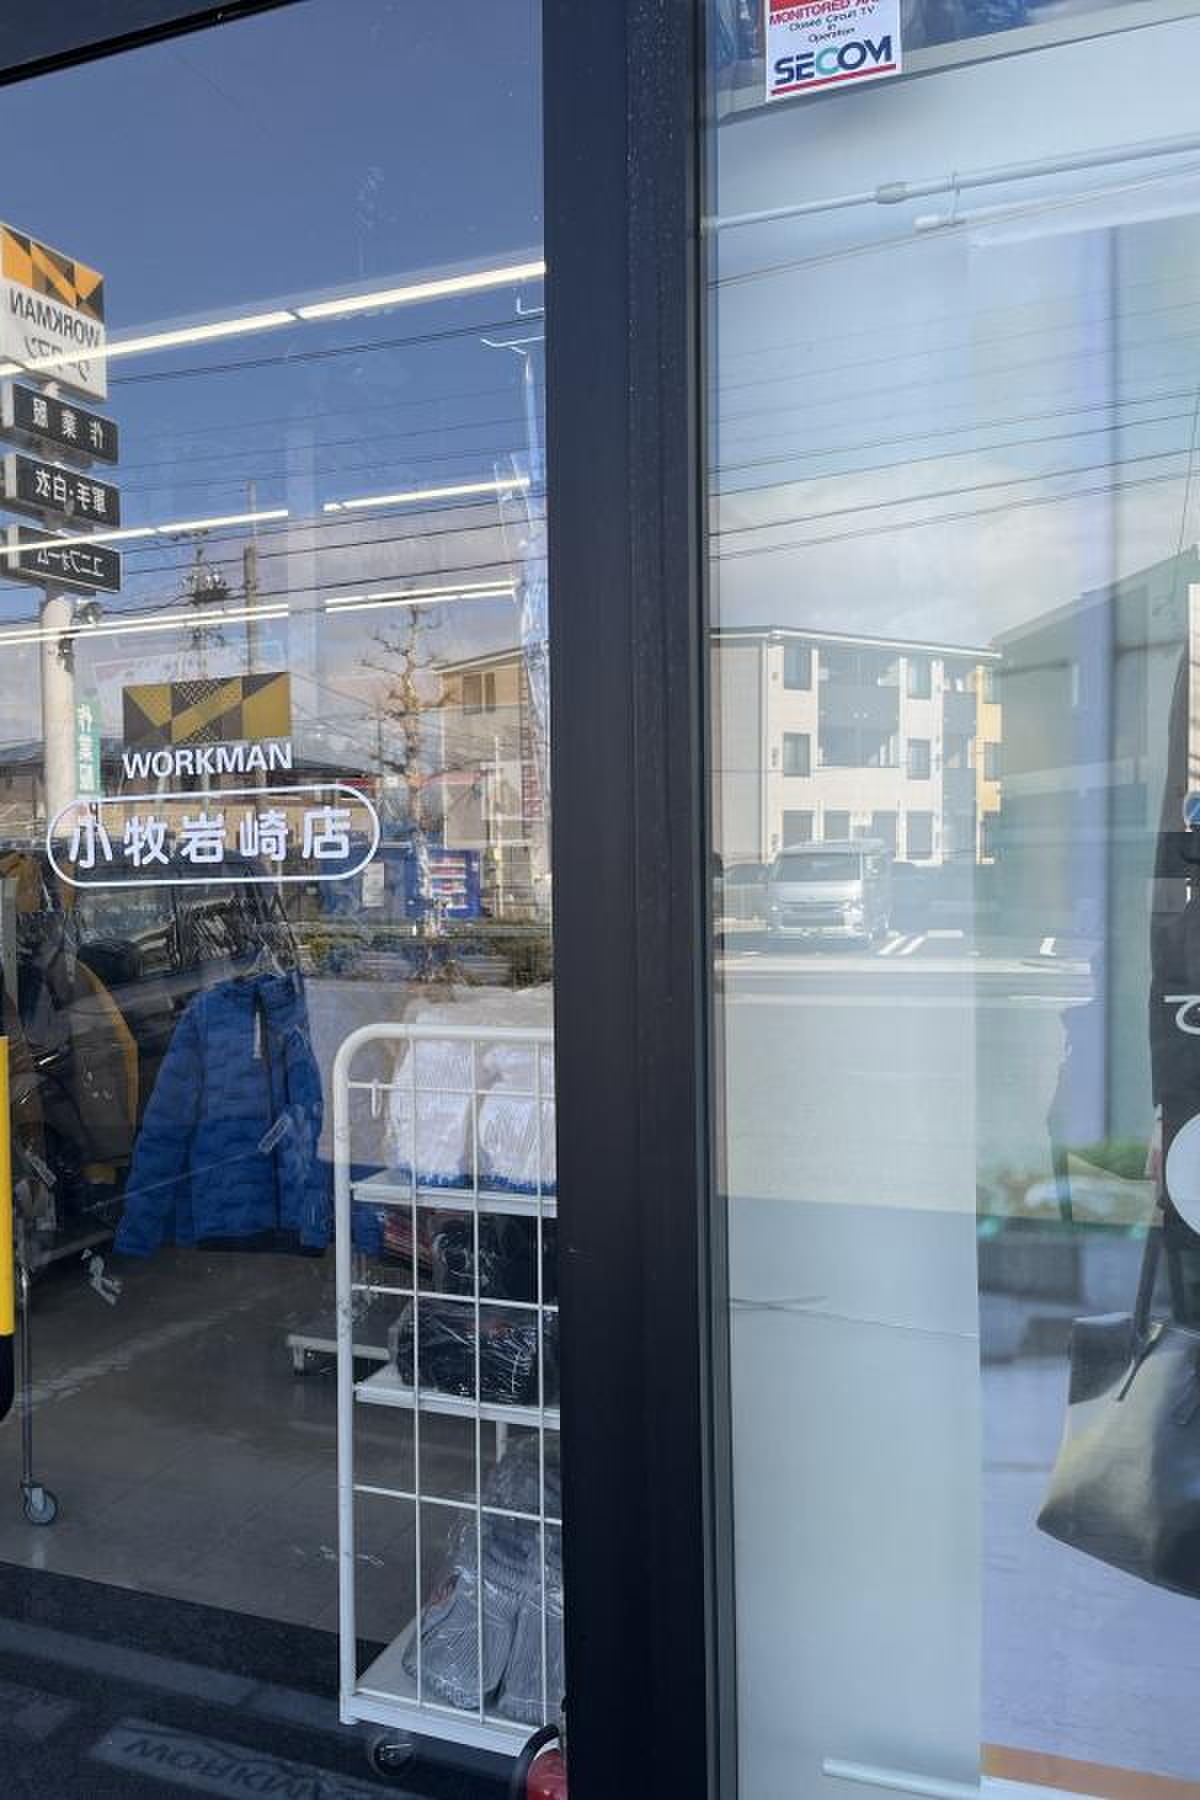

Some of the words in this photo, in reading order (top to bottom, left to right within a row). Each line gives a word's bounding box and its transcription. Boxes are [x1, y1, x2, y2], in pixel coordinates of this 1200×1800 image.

[774, 35, 893, 85] SECOM
[122, 743, 293, 779] WORKMAN
[68, 806, 351, 868] 小牧岩崎店
